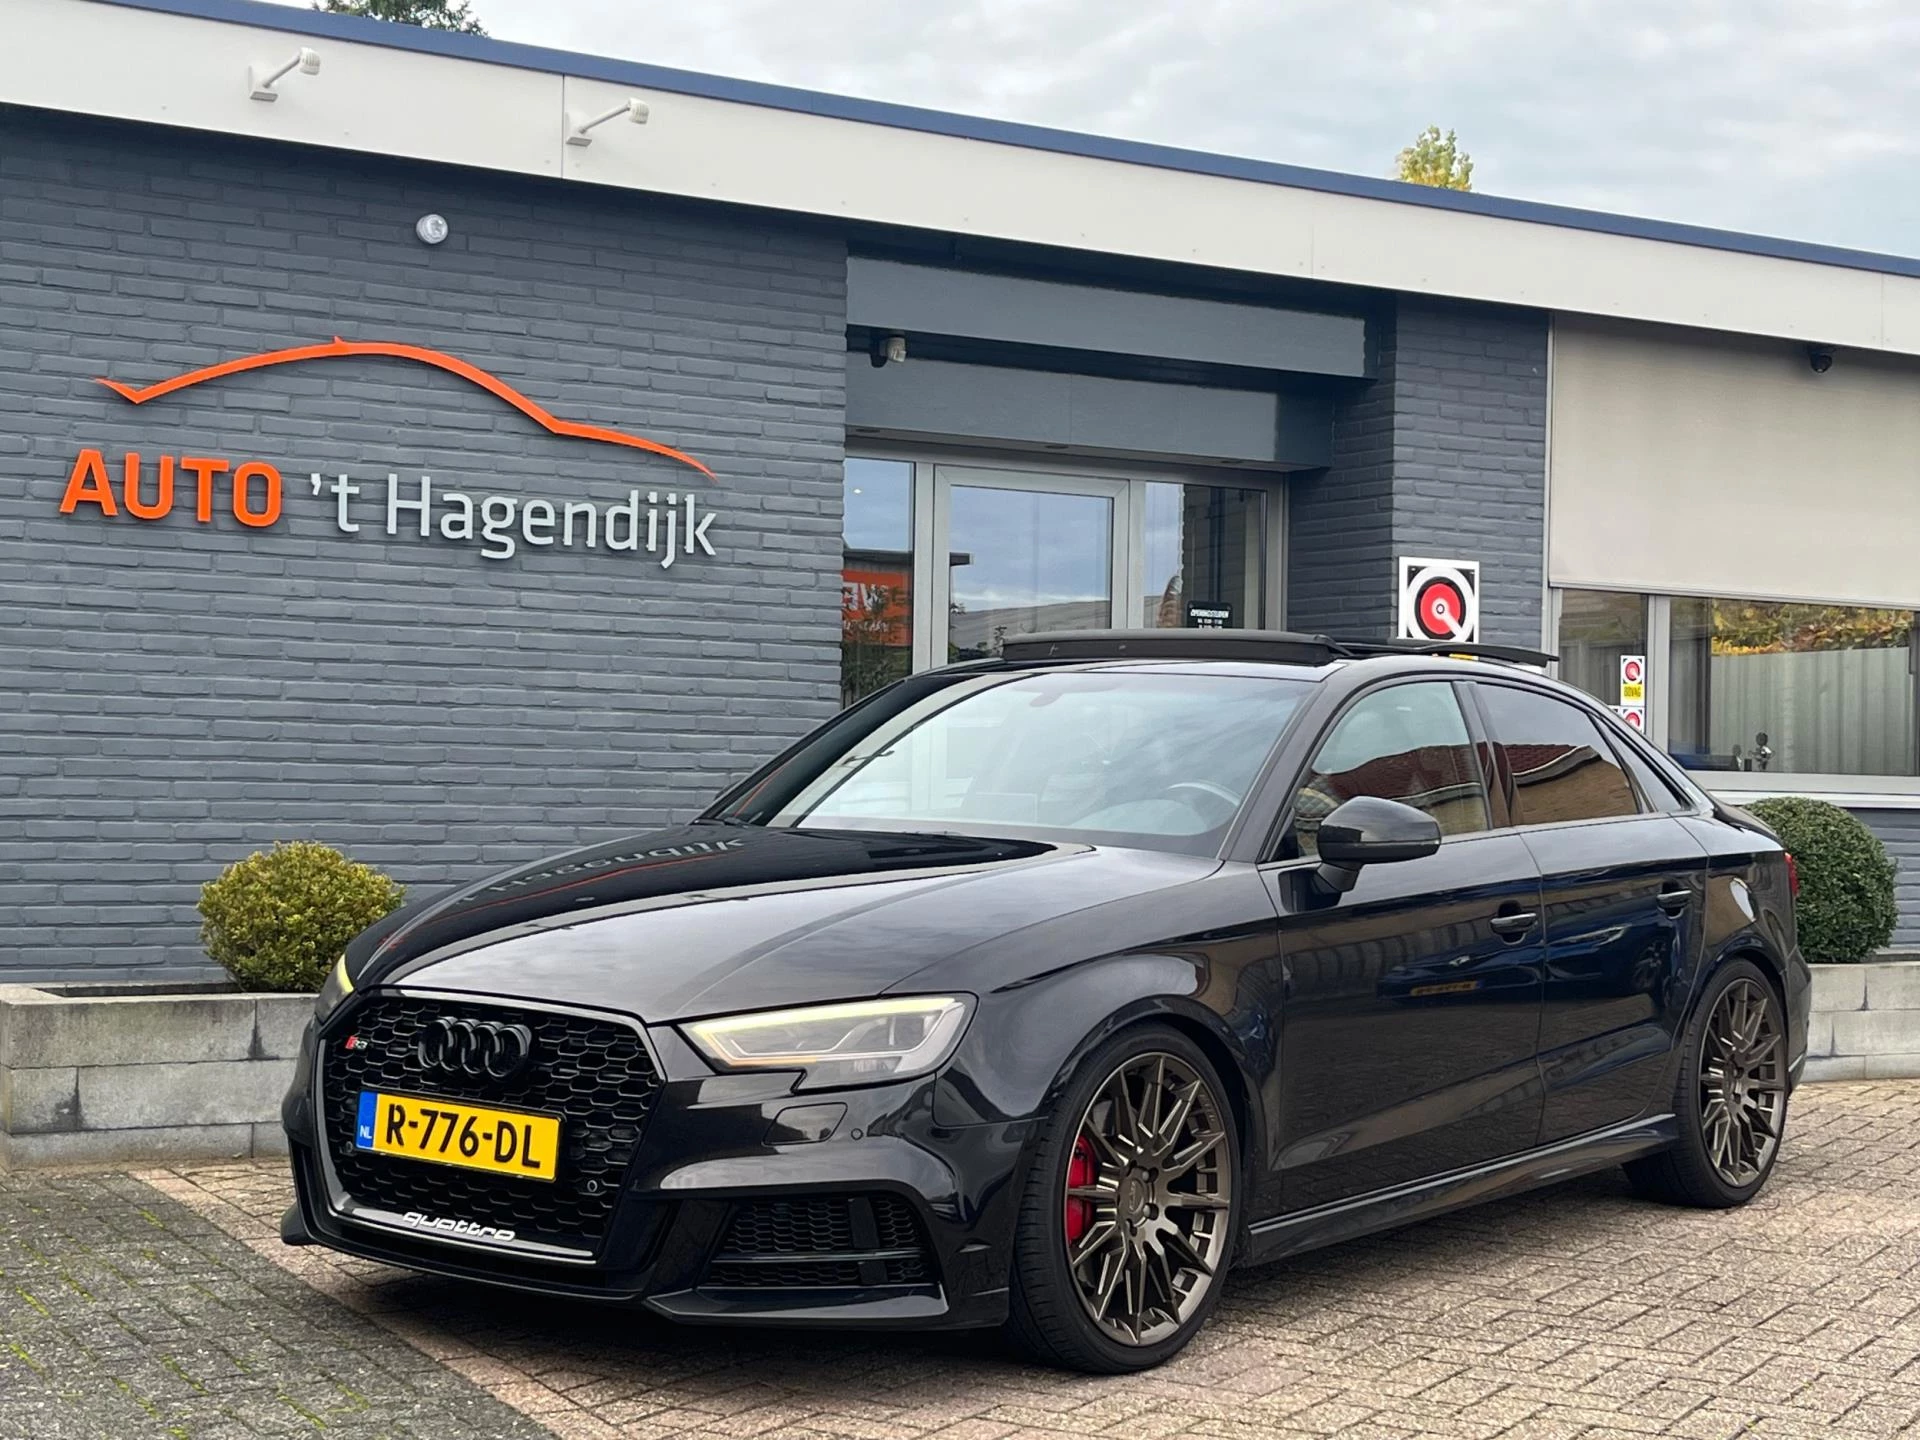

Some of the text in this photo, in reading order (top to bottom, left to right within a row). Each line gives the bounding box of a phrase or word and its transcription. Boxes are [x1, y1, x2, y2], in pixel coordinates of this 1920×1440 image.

[60, 449, 282, 528] AUTO
[387, 474, 717, 570] Hagendijk
[359, 1104, 541, 1169] NL R-776-DL
[403, 1211, 516, 1241] quattro
